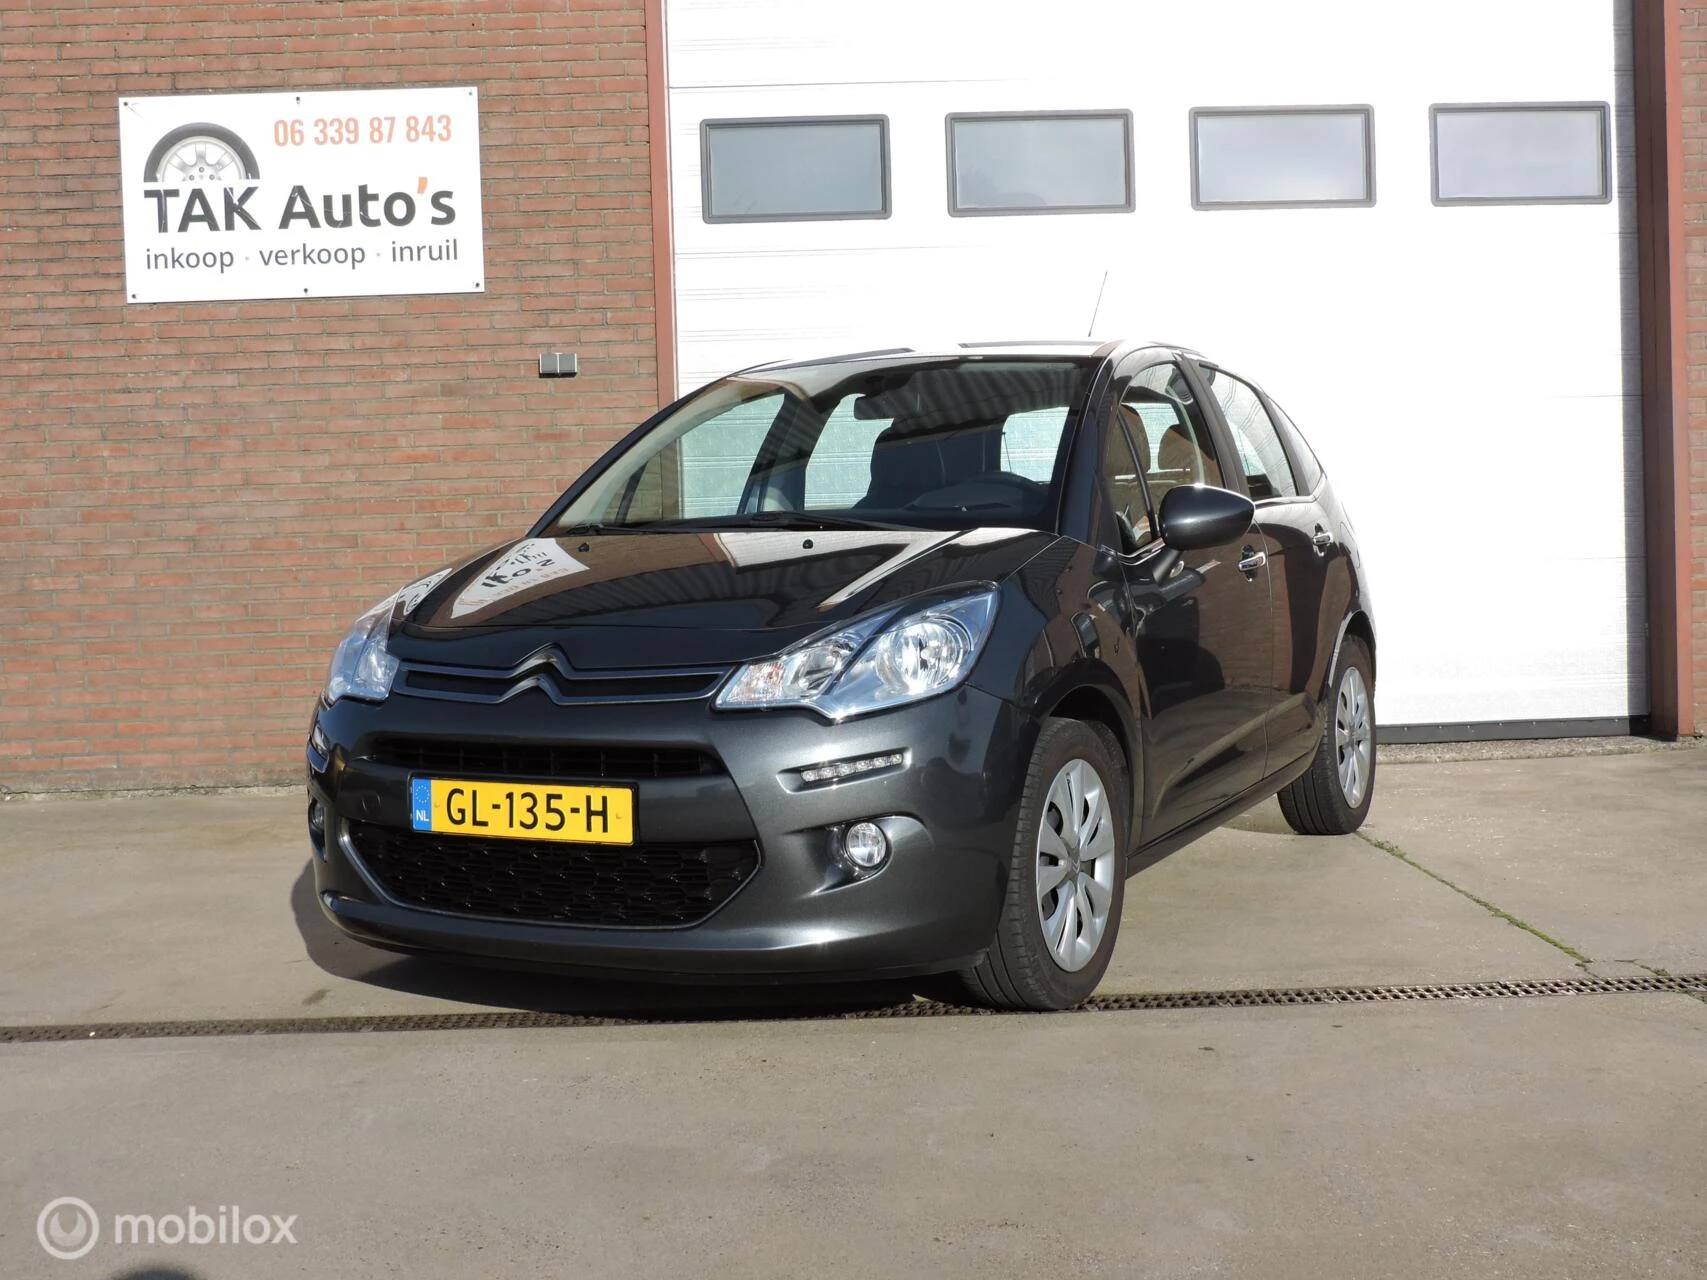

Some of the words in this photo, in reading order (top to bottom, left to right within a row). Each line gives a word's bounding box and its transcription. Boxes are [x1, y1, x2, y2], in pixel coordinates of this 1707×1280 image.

[274, 119, 305, 147] 06
[313, 117, 360, 146] 339
[369, 116, 396, 144] 87
[405, 114, 452, 143] 843
[143, 186, 262, 234] TAK
[278, 176, 457, 230] Auto's
[146, 247, 234, 274] inkoop
[258, 243, 366, 270] verkoop
[391, 239, 458, 263] inruil
[416, 809, 430, 823] NL
[446, 787, 609, 834] GL-135-H
